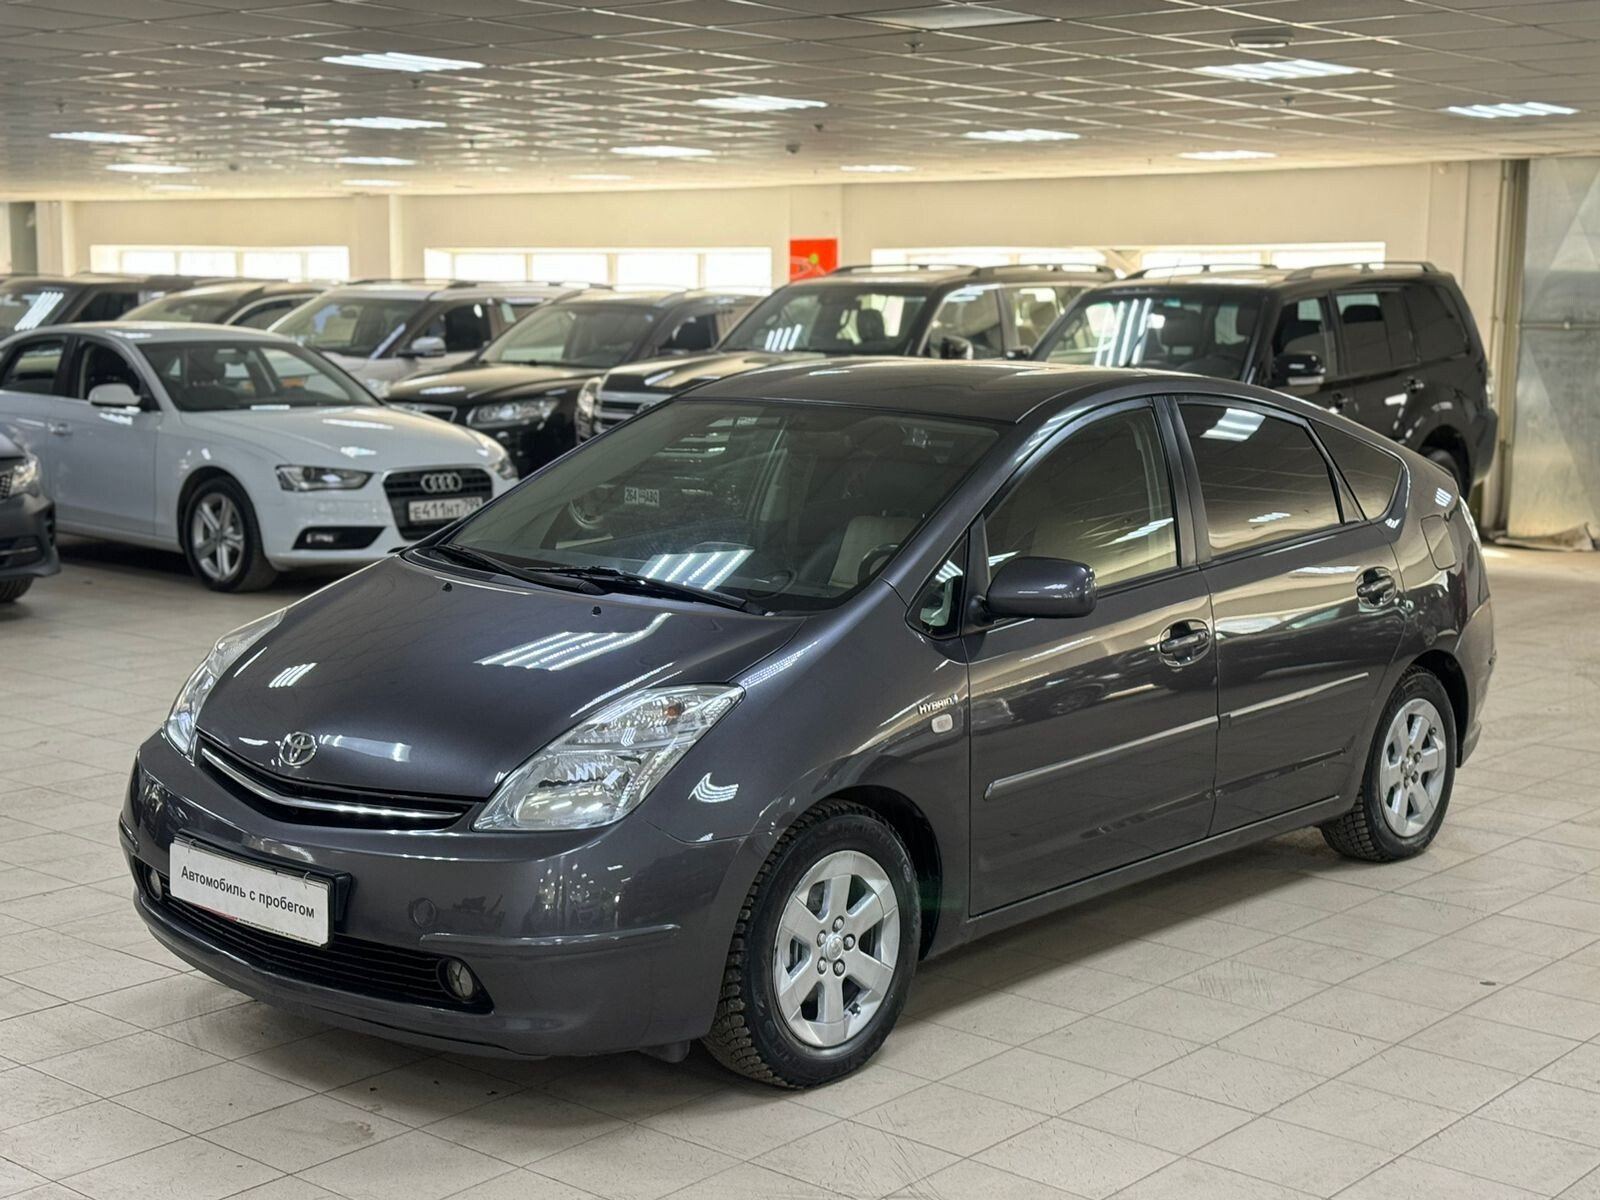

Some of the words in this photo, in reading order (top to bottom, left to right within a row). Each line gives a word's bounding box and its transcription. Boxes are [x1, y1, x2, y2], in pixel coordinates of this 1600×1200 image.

[181, 866, 246, 898] Автомобиль
[249, 889, 256, 901] с
[258, 893, 315, 919] пробегом
